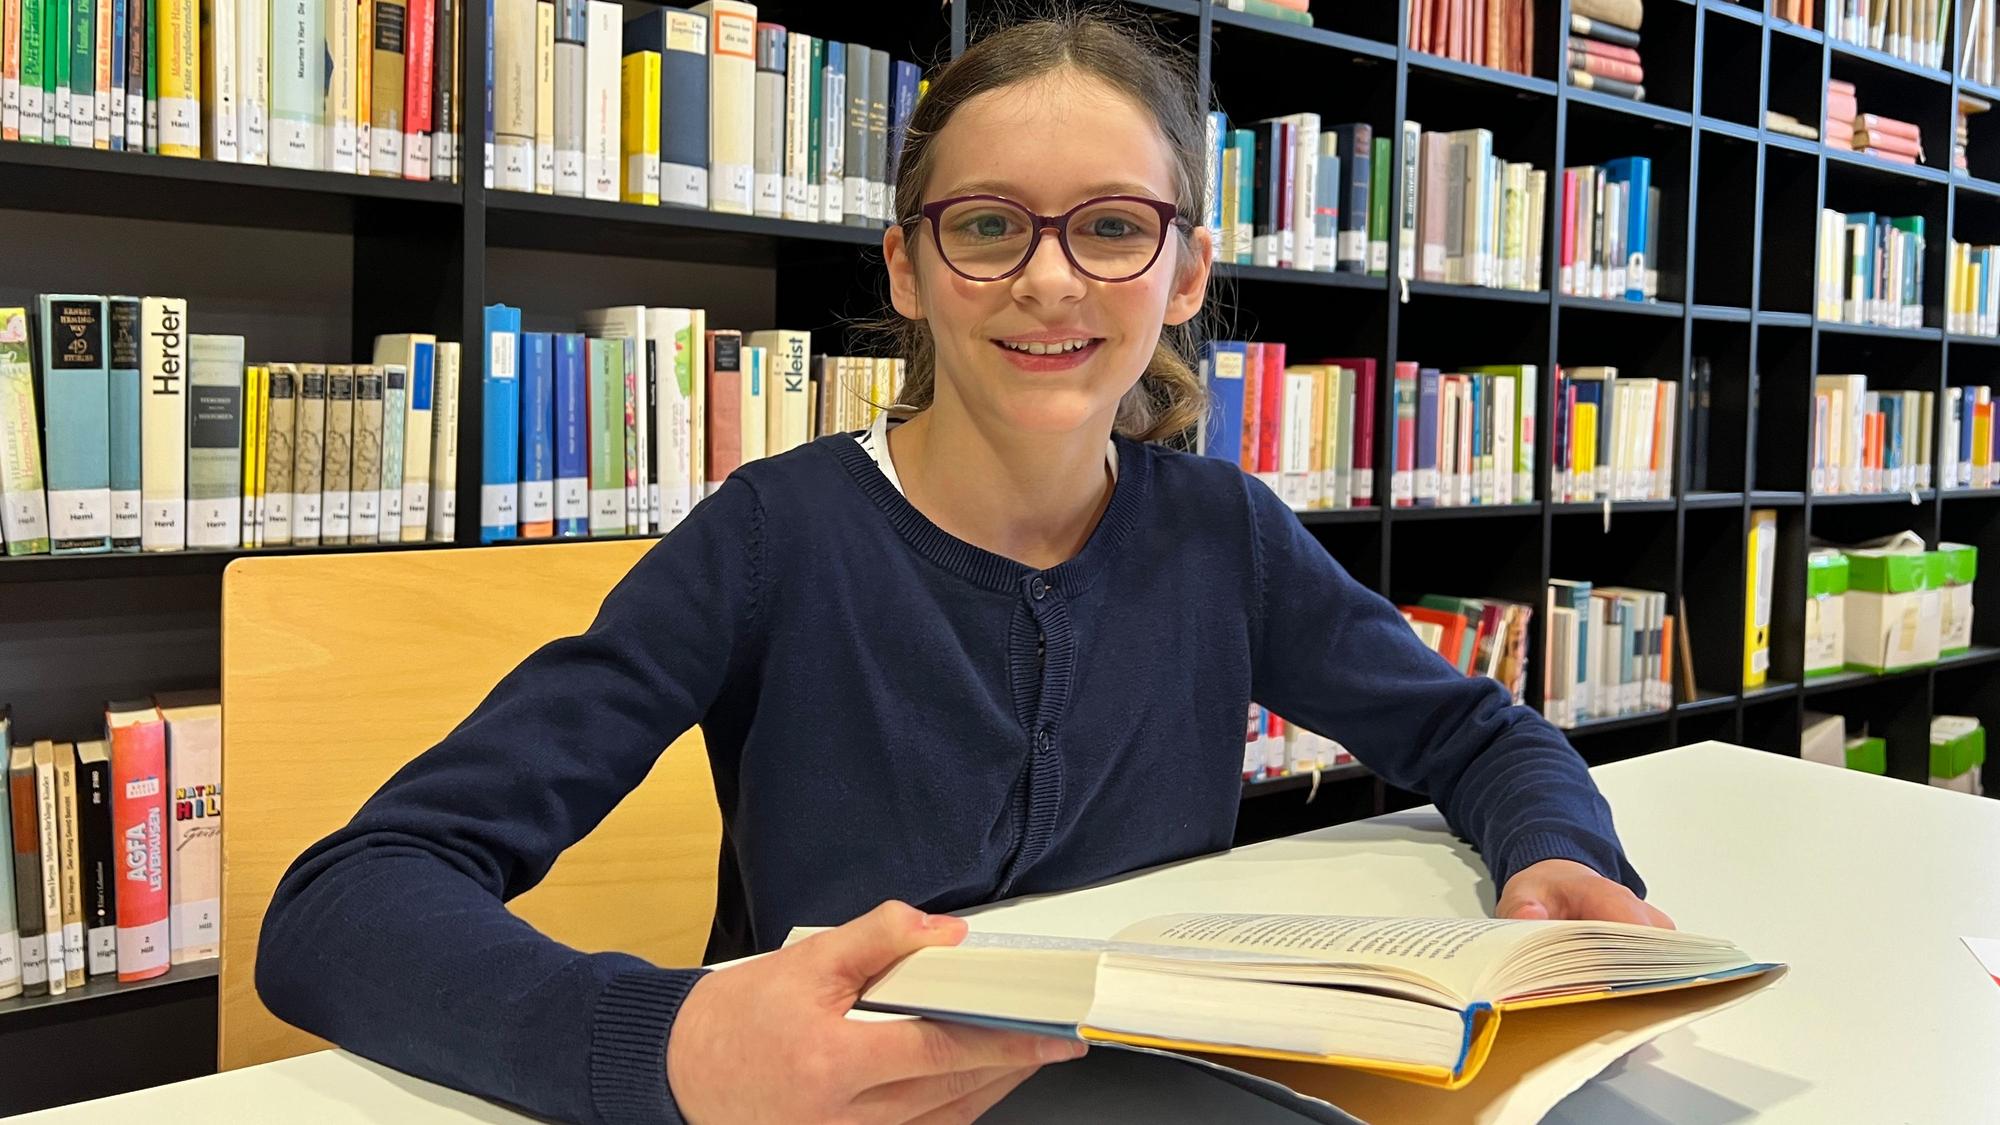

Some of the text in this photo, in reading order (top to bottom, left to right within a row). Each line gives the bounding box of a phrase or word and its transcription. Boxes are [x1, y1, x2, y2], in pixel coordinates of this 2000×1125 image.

[151, 304, 180, 395] Herder
[784, 337, 803, 392] Kleist
[70, 512, 93, 521] Hemi
[154, 520, 174, 528] Herd
[126, 822, 147, 881] AGFA
[148, 806, 162, 892] LEVERKUSEN
